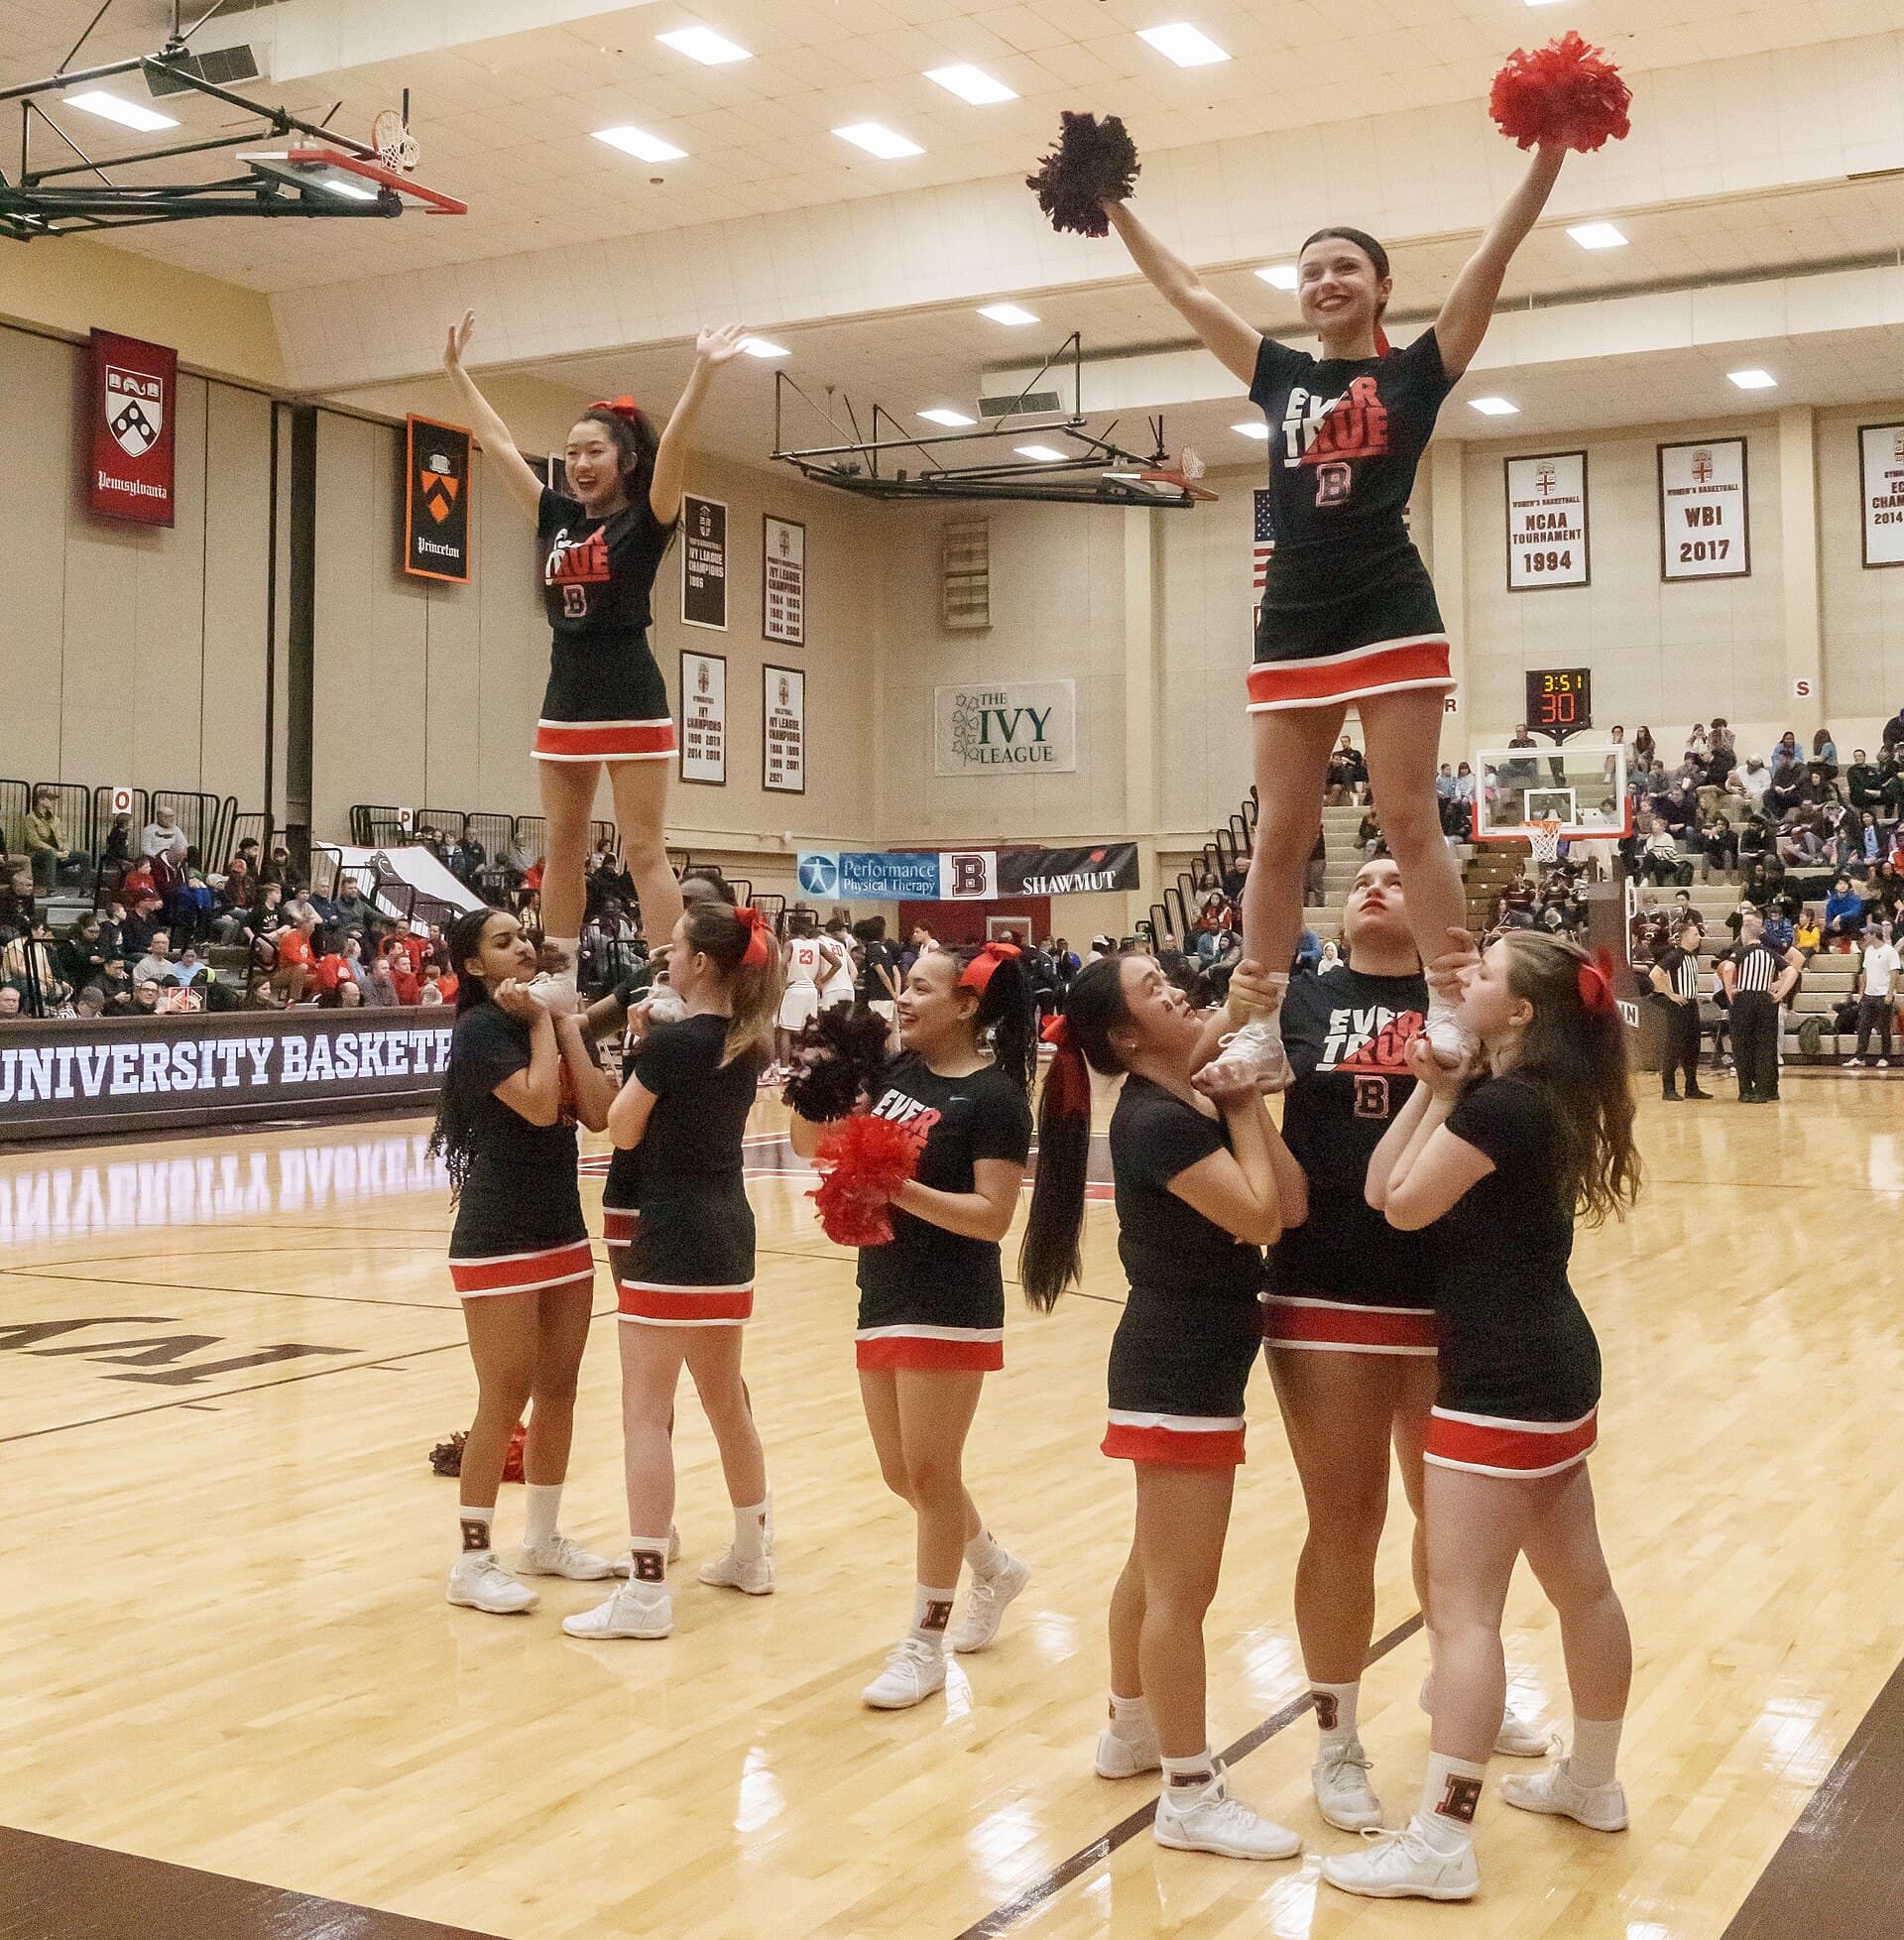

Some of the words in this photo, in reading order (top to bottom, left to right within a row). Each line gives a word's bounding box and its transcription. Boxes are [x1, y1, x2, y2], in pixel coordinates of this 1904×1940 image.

[1285, 376, 1383, 421] EVR
[1282, 406, 1388, 458] TRUE
[98, 470, 168, 499] Pennsylvania
[1316, 461, 1352, 507] B
[1525, 512, 1568, 531] NCAA
[1685, 506, 1723, 528] WBI
[1874, 512, 1903, 525] 2014
[417, 537, 460, 558] Princeton
[1512, 529, 1582, 545] TOURNAMENT
[1523, 550, 1572, 572] 1994
[1680, 540, 1729, 562] 2017
[563, 584, 587, 618] B
[1544, 674, 1582, 692] 3:51
[1796, 680, 1810, 696] S
[980, 692, 1008, 706] THE
[1445, 699, 1457, 712] R
[1541, 693, 1575, 723] 30
[978, 706, 1052, 745] IVY
[980, 746, 1054, 764] LEAGUE
[401, 810, 411, 826] P
[844, 860, 935, 878] Performance
[952, 854, 987, 898] B
[843, 878, 888, 894] Physical
[892, 879, 936, 895] Therapy
[1022, 870, 1117, 896] SHAWMUT
[799, 948, 813, 965] 23
[1329, 1005, 1425, 1037] EVER
[1322, 1031, 1408, 1067] TRU
[1354, 1074, 1389, 1119] B
[873, 1088, 942, 1140] EVER
[460, 1518, 492, 1554] B
[631, 1548, 667, 1584] B
